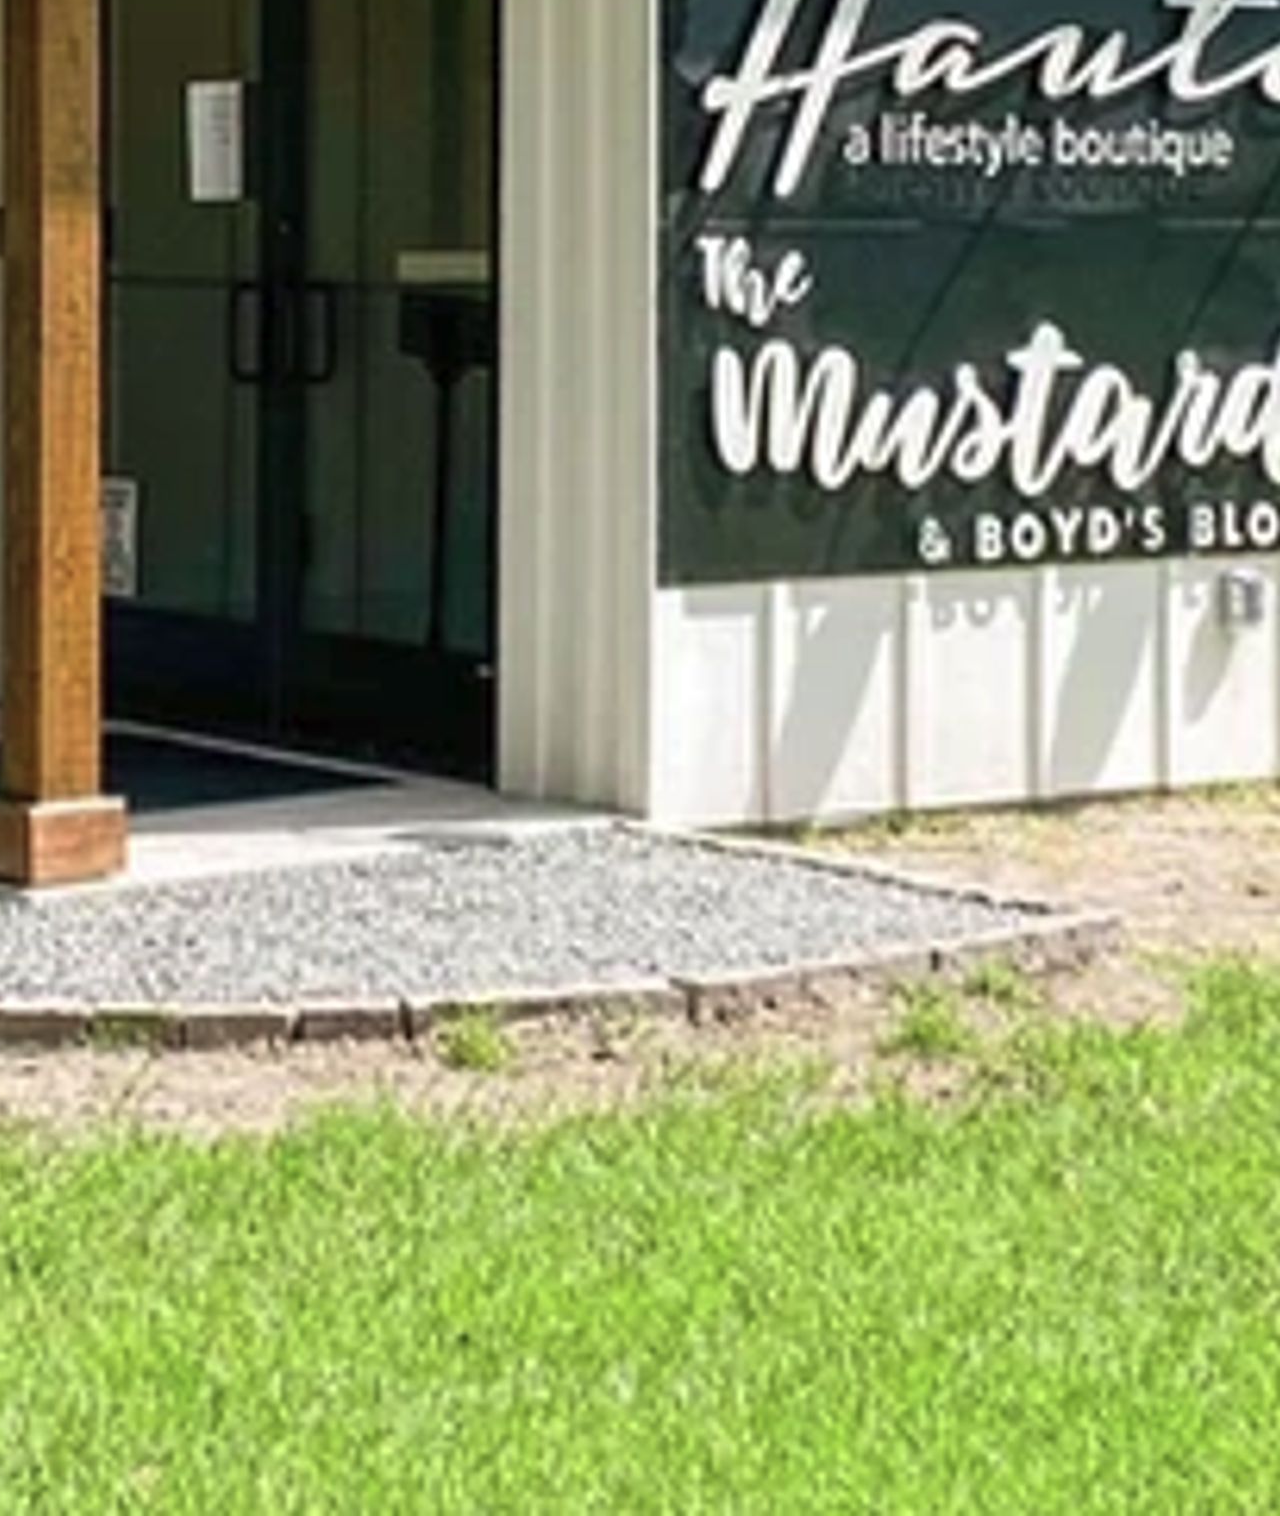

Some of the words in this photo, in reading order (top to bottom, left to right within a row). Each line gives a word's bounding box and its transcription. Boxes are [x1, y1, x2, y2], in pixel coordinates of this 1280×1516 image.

[842, 124, 871, 166] a
[879, 111, 1044, 177] lifestyle
[1053, 117, 1235, 176] boutique
[695, 234, 813, 327] The
[918, 517, 951, 563] &
[974, 505, 1166, 561] BOYD'S
